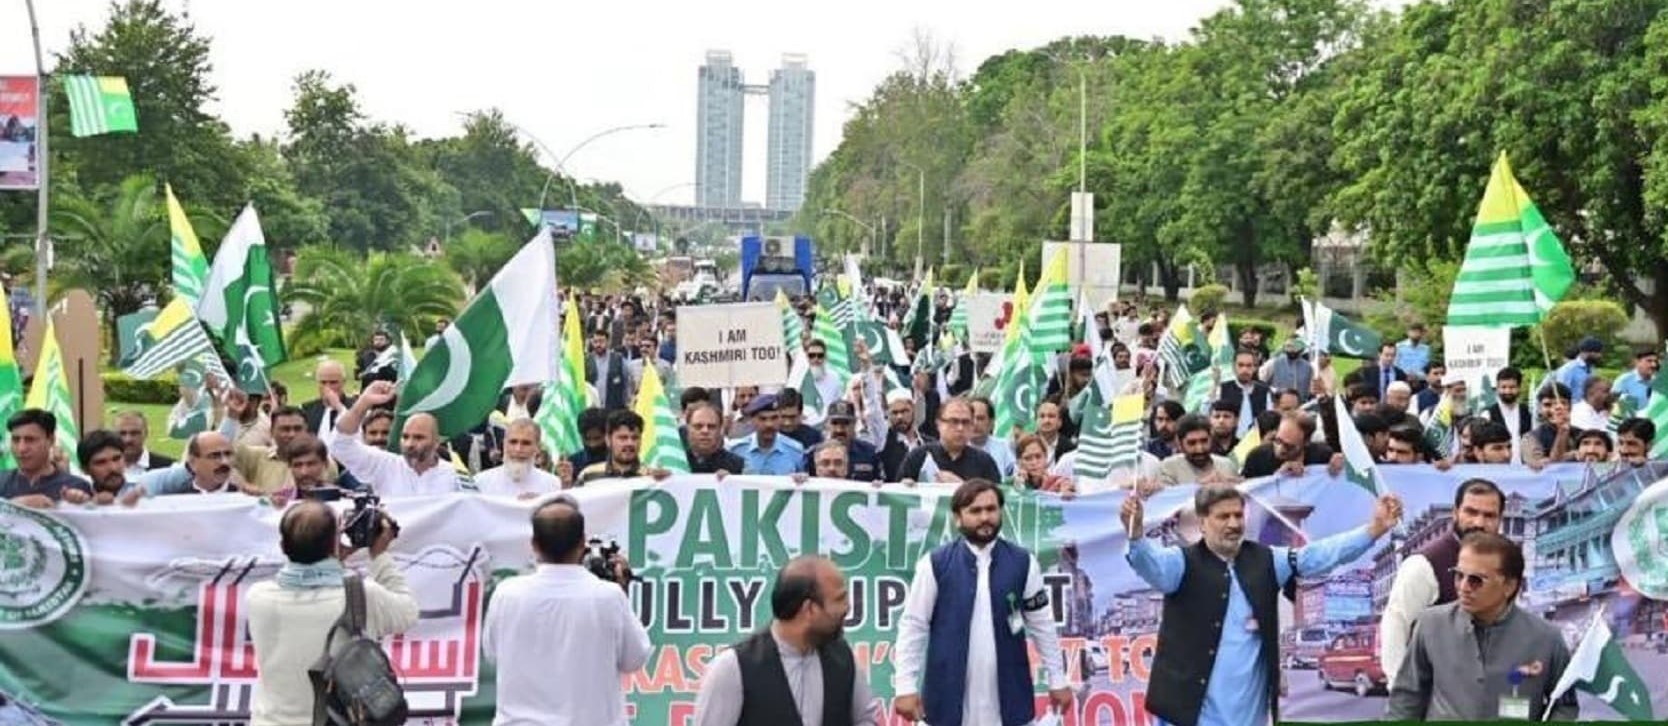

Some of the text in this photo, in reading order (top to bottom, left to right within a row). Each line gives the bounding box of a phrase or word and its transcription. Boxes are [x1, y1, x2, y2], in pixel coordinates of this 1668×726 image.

[718, 329, 747, 343] I AM
[685, 347, 780, 364] KASHMIRI TOO!
